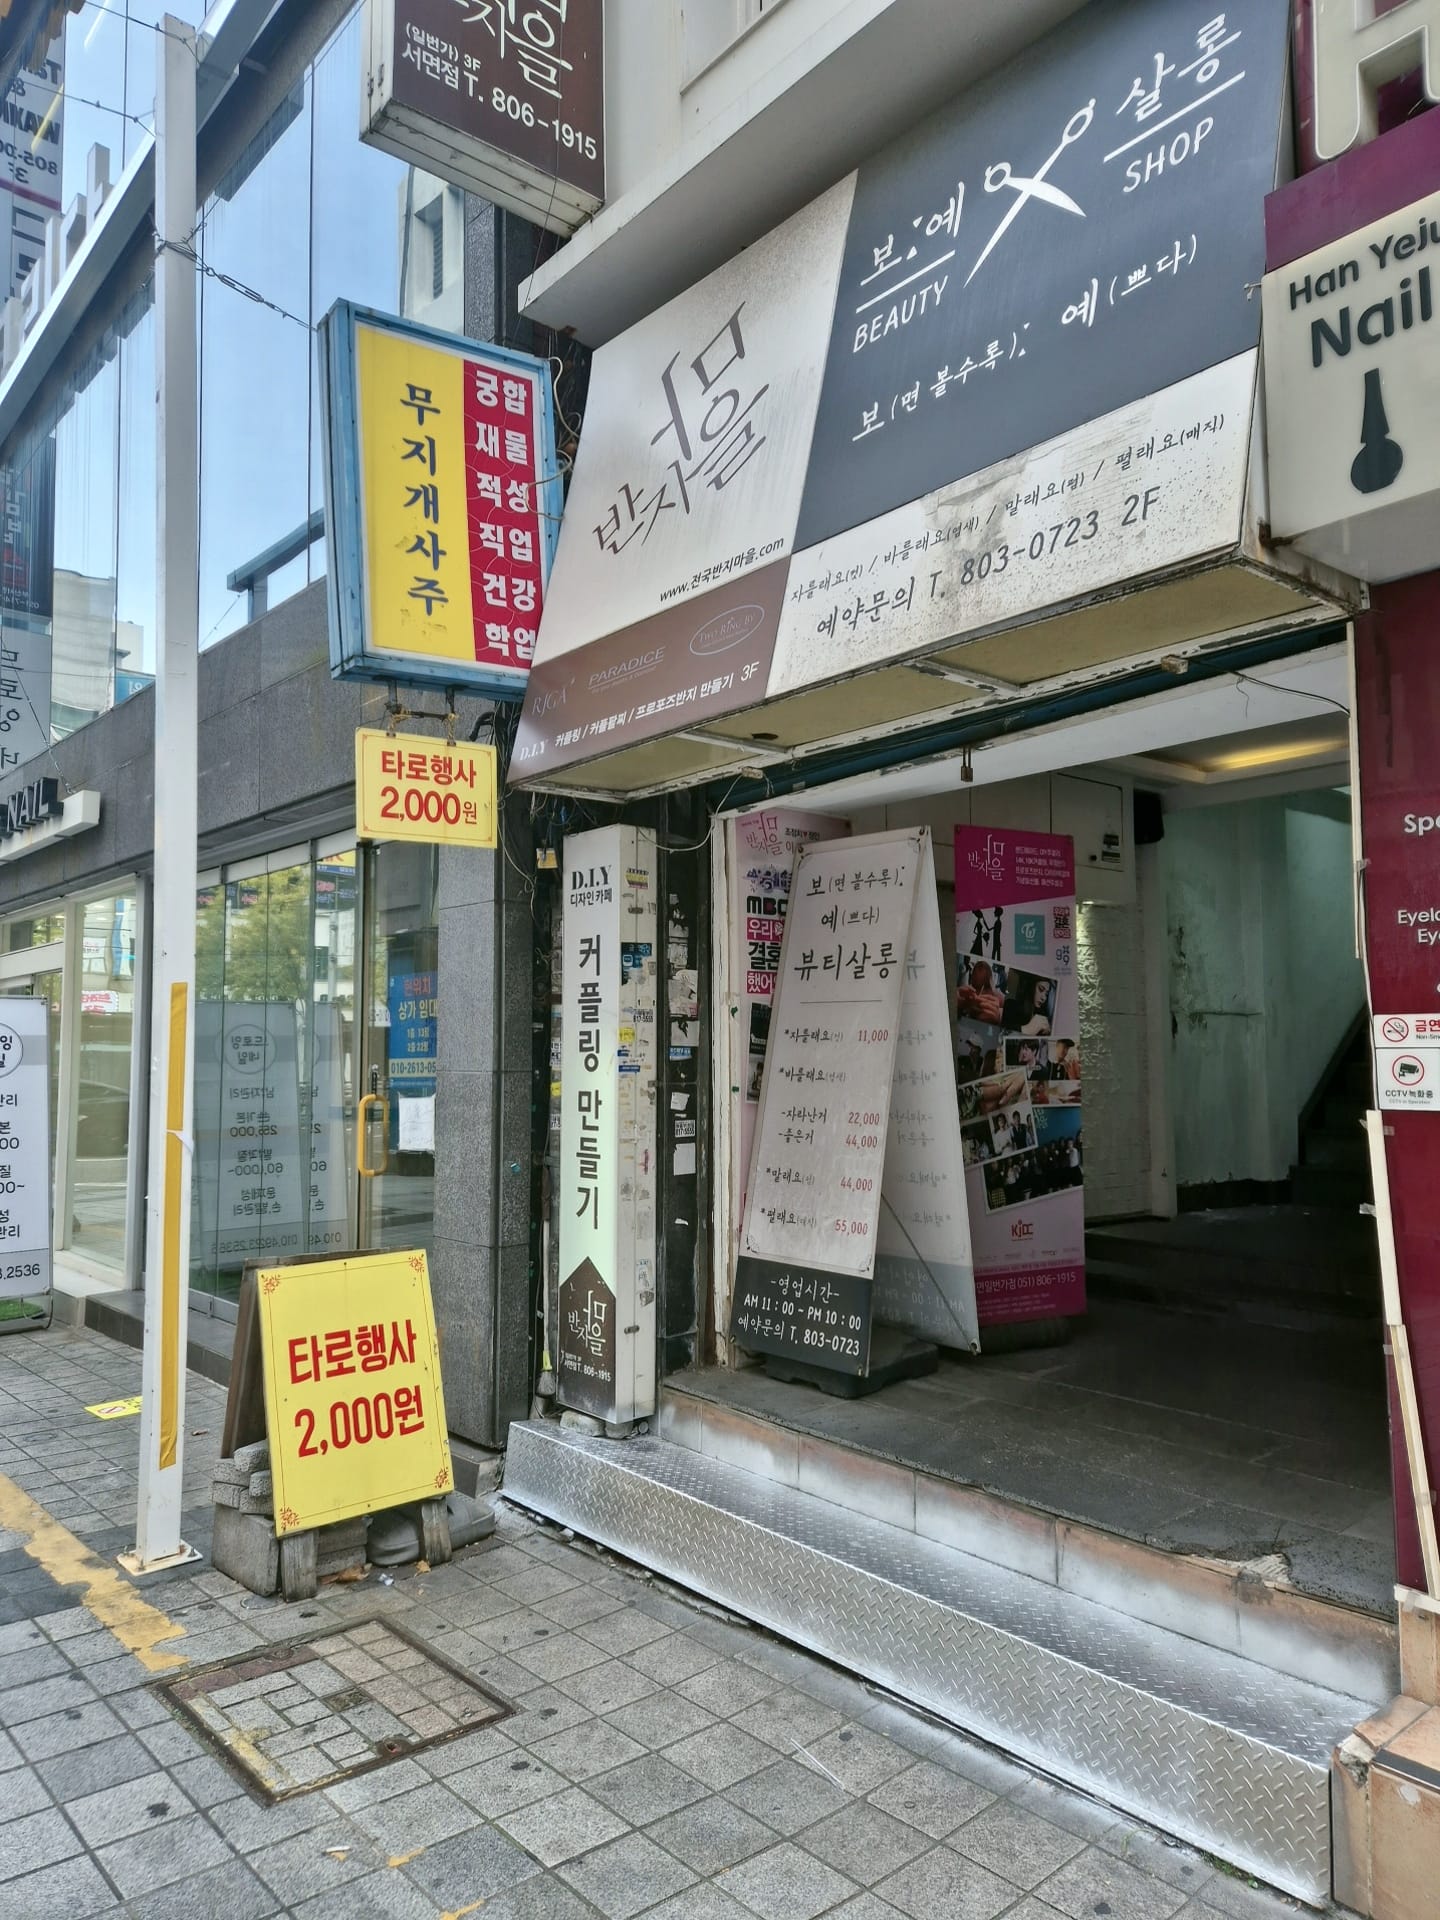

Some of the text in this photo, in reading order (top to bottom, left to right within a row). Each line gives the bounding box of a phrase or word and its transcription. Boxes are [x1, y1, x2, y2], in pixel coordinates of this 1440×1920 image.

[406, 22, 482, 71] (일번가) 3F
[1115, 13, 1242, 122] 살롱
[402, 43, 597, 160] 서면점 T. 806-1915
[1123, 116, 1214, 193] SHOP
[1289, 259, 1360, 311] Han
[853, 276, 949, 354] BEAUTY
[1311, 265, 1433, 368] Nail
[475, 369, 528, 416] 궁합
[475, 421, 529, 466] 재물
[400, 382, 449, 617] 무지개사주
[476, 471, 530, 514] 적성
[479, 521, 533, 563] 직업
[817, 576, 915, 639] 예약문의
[960, 510, 1100, 587] 803-0723
[1121, 485, 1162, 527] 2F
[659, 536, 785, 603] www.전국반지마을.com
[482, 572, 537, 613] 건강
[485, 621, 537, 660] 학업
[554, 726, 582, 748] 커플링
[589, 709, 628, 735] 커플팔찌
[635, 685, 697, 720] 프로포즈반지
[699, 673, 735, 699] 만들기
[740, 660, 760, 683] 3F
[381, 749, 477, 789] 타로행사
[6, 777, 58, 835] NAIL
[380, 785, 478, 825] 2,000원
[571, 864, 612, 891] D.I.Y
[748, 918, 774, 939] 우리
[794, 942, 898, 981] 뷰티살롱
[398, 1001, 417, 1021] 상가
[577, 934, 602, 1073] 커플링
[858, 1029, 889, 1044] 11,000
[1385, 1089, 1408, 1098] CCTV
[848, 1111, 880, 1127] 22,000
[576, 1088, 602, 1230] 만들기
[845, 1134, 878, 1150] 44,000
[840, 1177, 873, 1192] 44,000
[834, 1218, 868, 1236] 55,000
[1036, 1271, 1077, 1286] 806-1915
[288, 1319, 417, 1385] 타로행사
[738, 1313, 785, 1341] 예약문의
[803, 1329, 860, 1357] 803-0723
[294, 1384, 425, 1458] 2,000원
